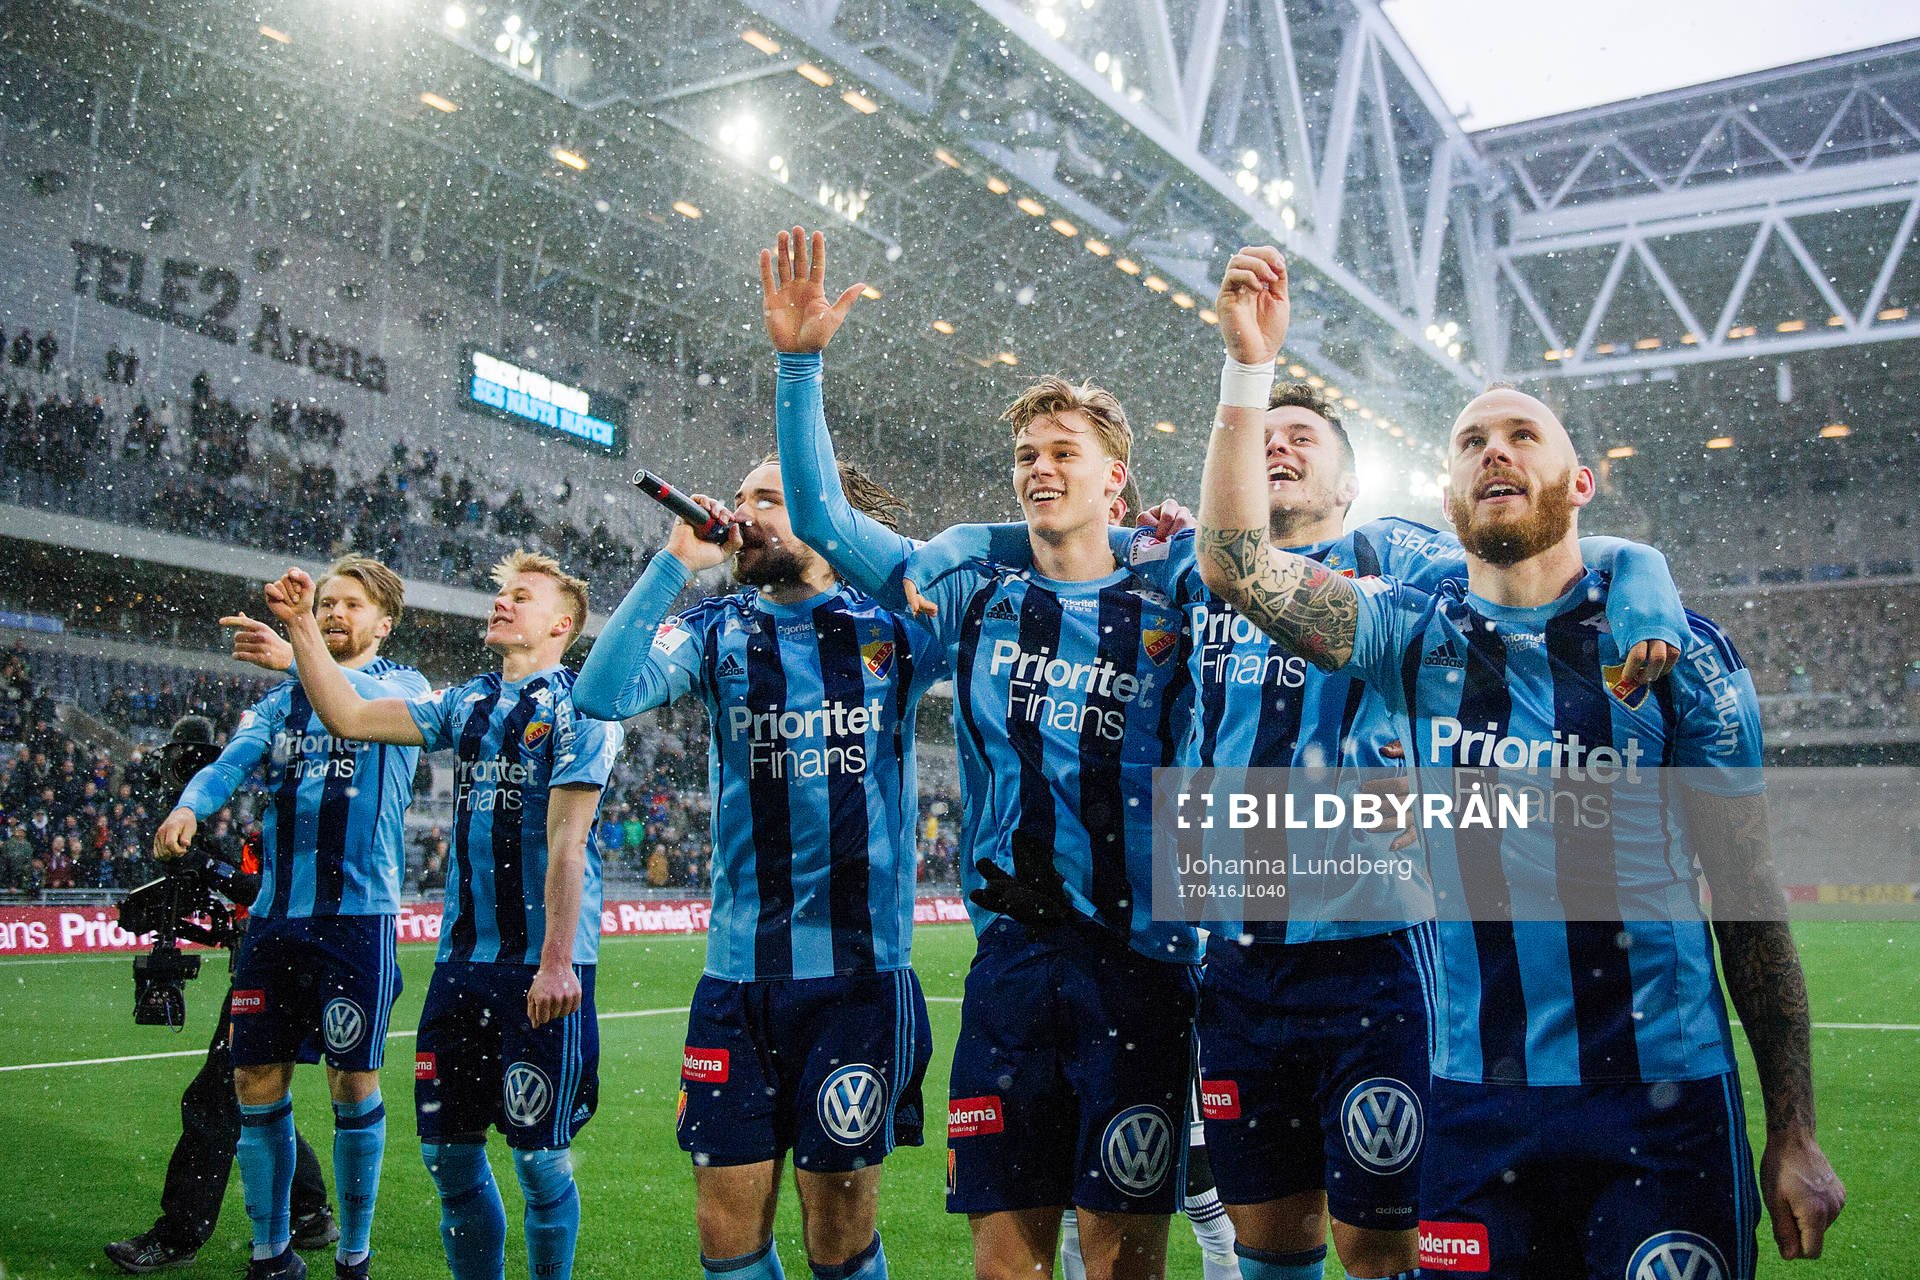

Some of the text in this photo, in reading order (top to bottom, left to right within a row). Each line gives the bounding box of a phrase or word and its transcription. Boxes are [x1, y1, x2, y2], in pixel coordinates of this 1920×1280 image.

[70, 239, 241, 345] TELE2
[249, 303, 389, 395] Arena
[987, 611, 1018, 622] adidas
[717, 666, 745, 678] adidas
[990, 639, 1155, 708] Prioritet
[1200, 644, 1307, 688] Finans
[1424, 655, 1465, 669] adidas
[728, 698, 884, 742] Prioritet
[1007, 680, 1125, 741] Finans
[285, 755, 356, 779] Finans
[750, 742, 867, 780] Finans
[1431, 716, 1644, 785] Prioritet
[1454, 767, 1611, 829] Finans
[619, 904, 695, 931] Prioritet
[823, 1070, 883, 1139] VW
[1347, 1086, 1418, 1167] VW
[1107, 1112, 1171, 1188] VW
[1376, 1205, 1413, 1215] adidas
[535, 1261, 563, 1276] DIF
